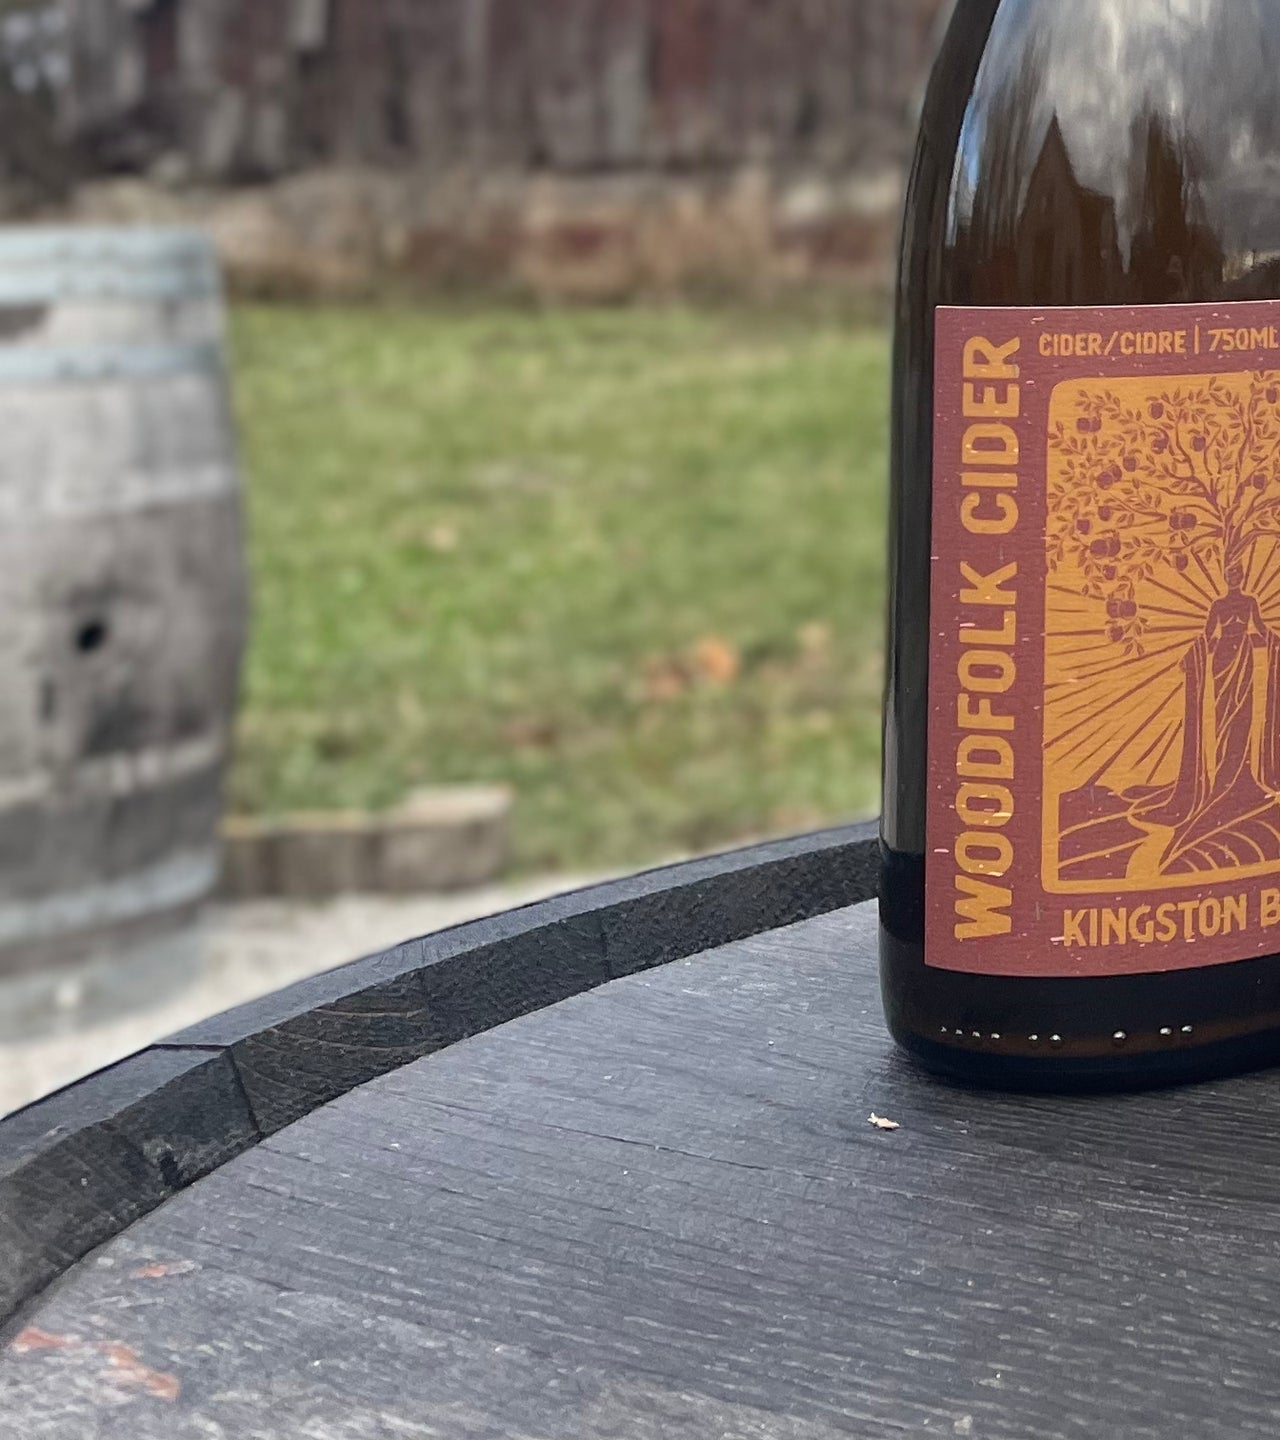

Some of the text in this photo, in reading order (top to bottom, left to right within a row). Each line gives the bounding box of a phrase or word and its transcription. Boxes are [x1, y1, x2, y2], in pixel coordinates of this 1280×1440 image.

[1038, 328, 1186, 357] CIDER/CIDRE
[1207, 325, 1279, 352] 750ML
[953, 335, 1021, 942] WOODFOLK CIDER
[1062, 892, 1248, 948] KINGSTON
